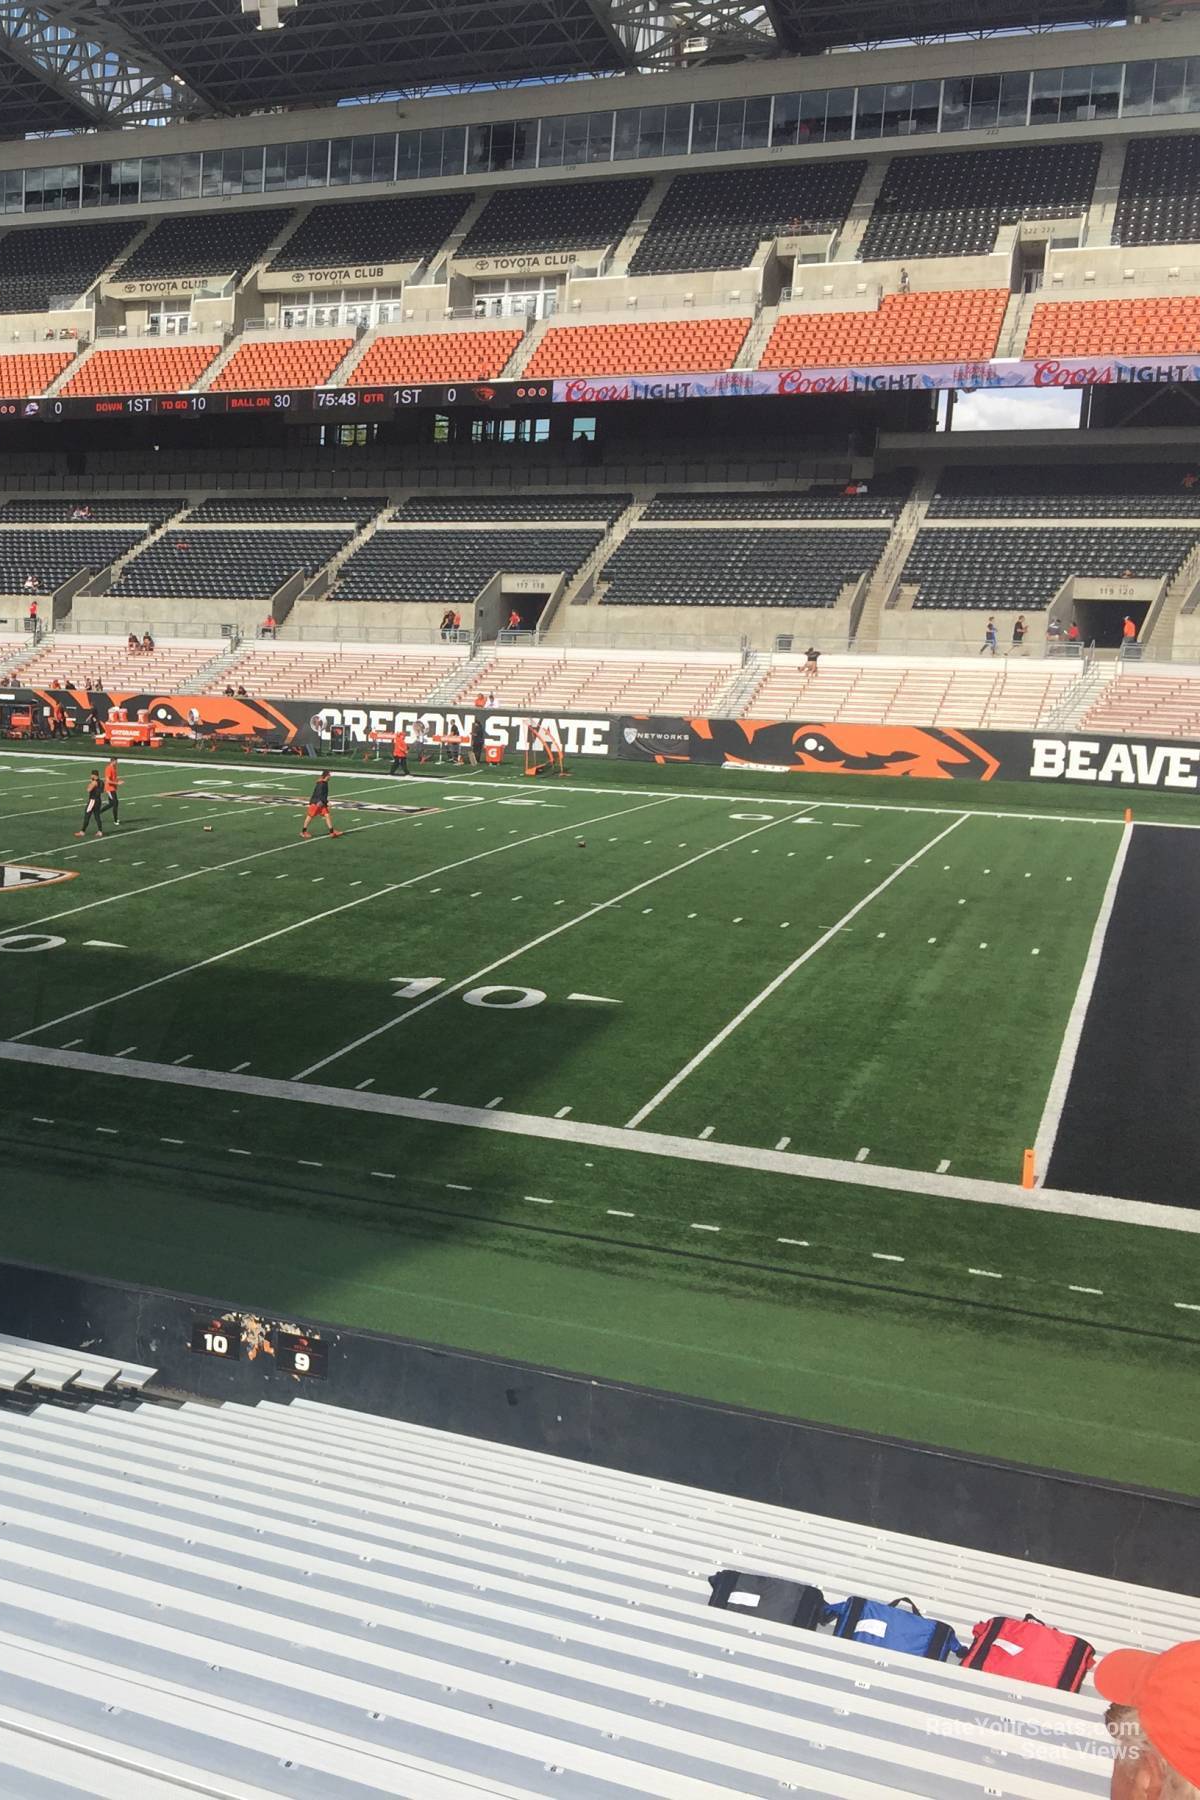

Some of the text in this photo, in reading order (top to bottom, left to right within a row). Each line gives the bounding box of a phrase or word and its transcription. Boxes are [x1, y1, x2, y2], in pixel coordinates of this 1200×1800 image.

[493, 254, 577, 269] TOYOTA CLUB
[308, 267, 384, 281] TOYOTA CLUB
[139, 279, 208, 292] TOYOTA CLUB
[1034, 361, 1188, 386] Coors LIGHT
[778, 370, 918, 395] Coors LIGHT
[392, 389, 422, 404] 1ST
[447, 388, 457, 402] 0
[565, 379, 691, 402] Coors LIGHT
[96, 399, 152, 412] DOWN 1ST
[161, 397, 206, 410] TO GO 10
[231, 394, 291, 408] BALL ON 30
[317, 392, 357, 407] 75:48
[54, 401, 62, 415] 0
[484, 715, 610, 755] STATE
[637, 732, 690, 741] NETWORKS
[488, 749, 498, 758] G
[1030, 738, 1200, 789] BEAVE
[389, 976, 548, 1009] 10
[203, 1333, 229, 1354] 10
[294, 1352, 311, 1372] 9
